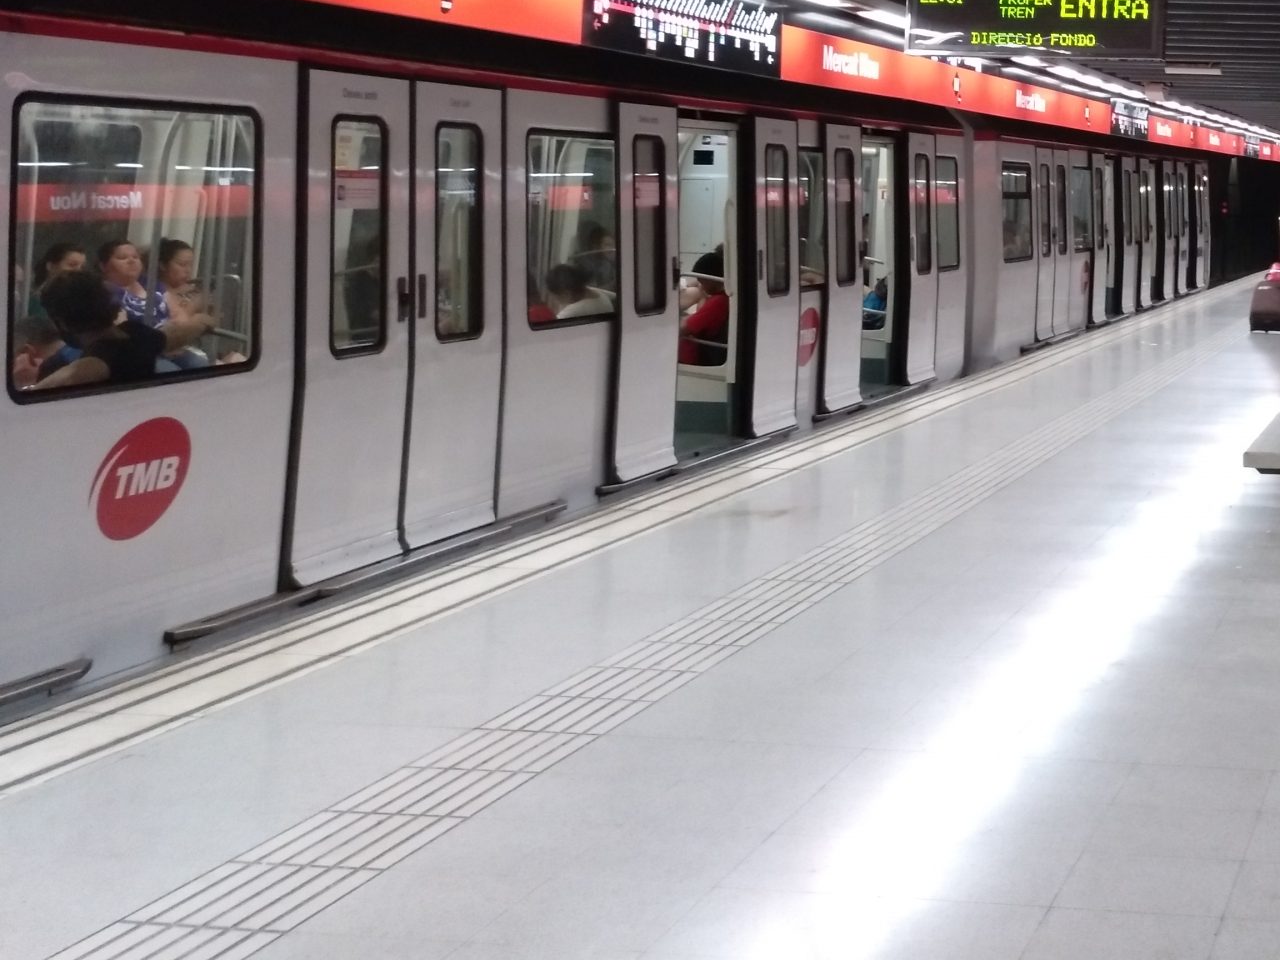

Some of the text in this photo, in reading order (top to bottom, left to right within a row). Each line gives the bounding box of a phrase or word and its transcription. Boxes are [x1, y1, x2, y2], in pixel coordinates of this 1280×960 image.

[1000, 6, 1035, 19] TREN
[1050, 33, 1096, 47] FONDO
[114, 456, 180, 500] TMB
